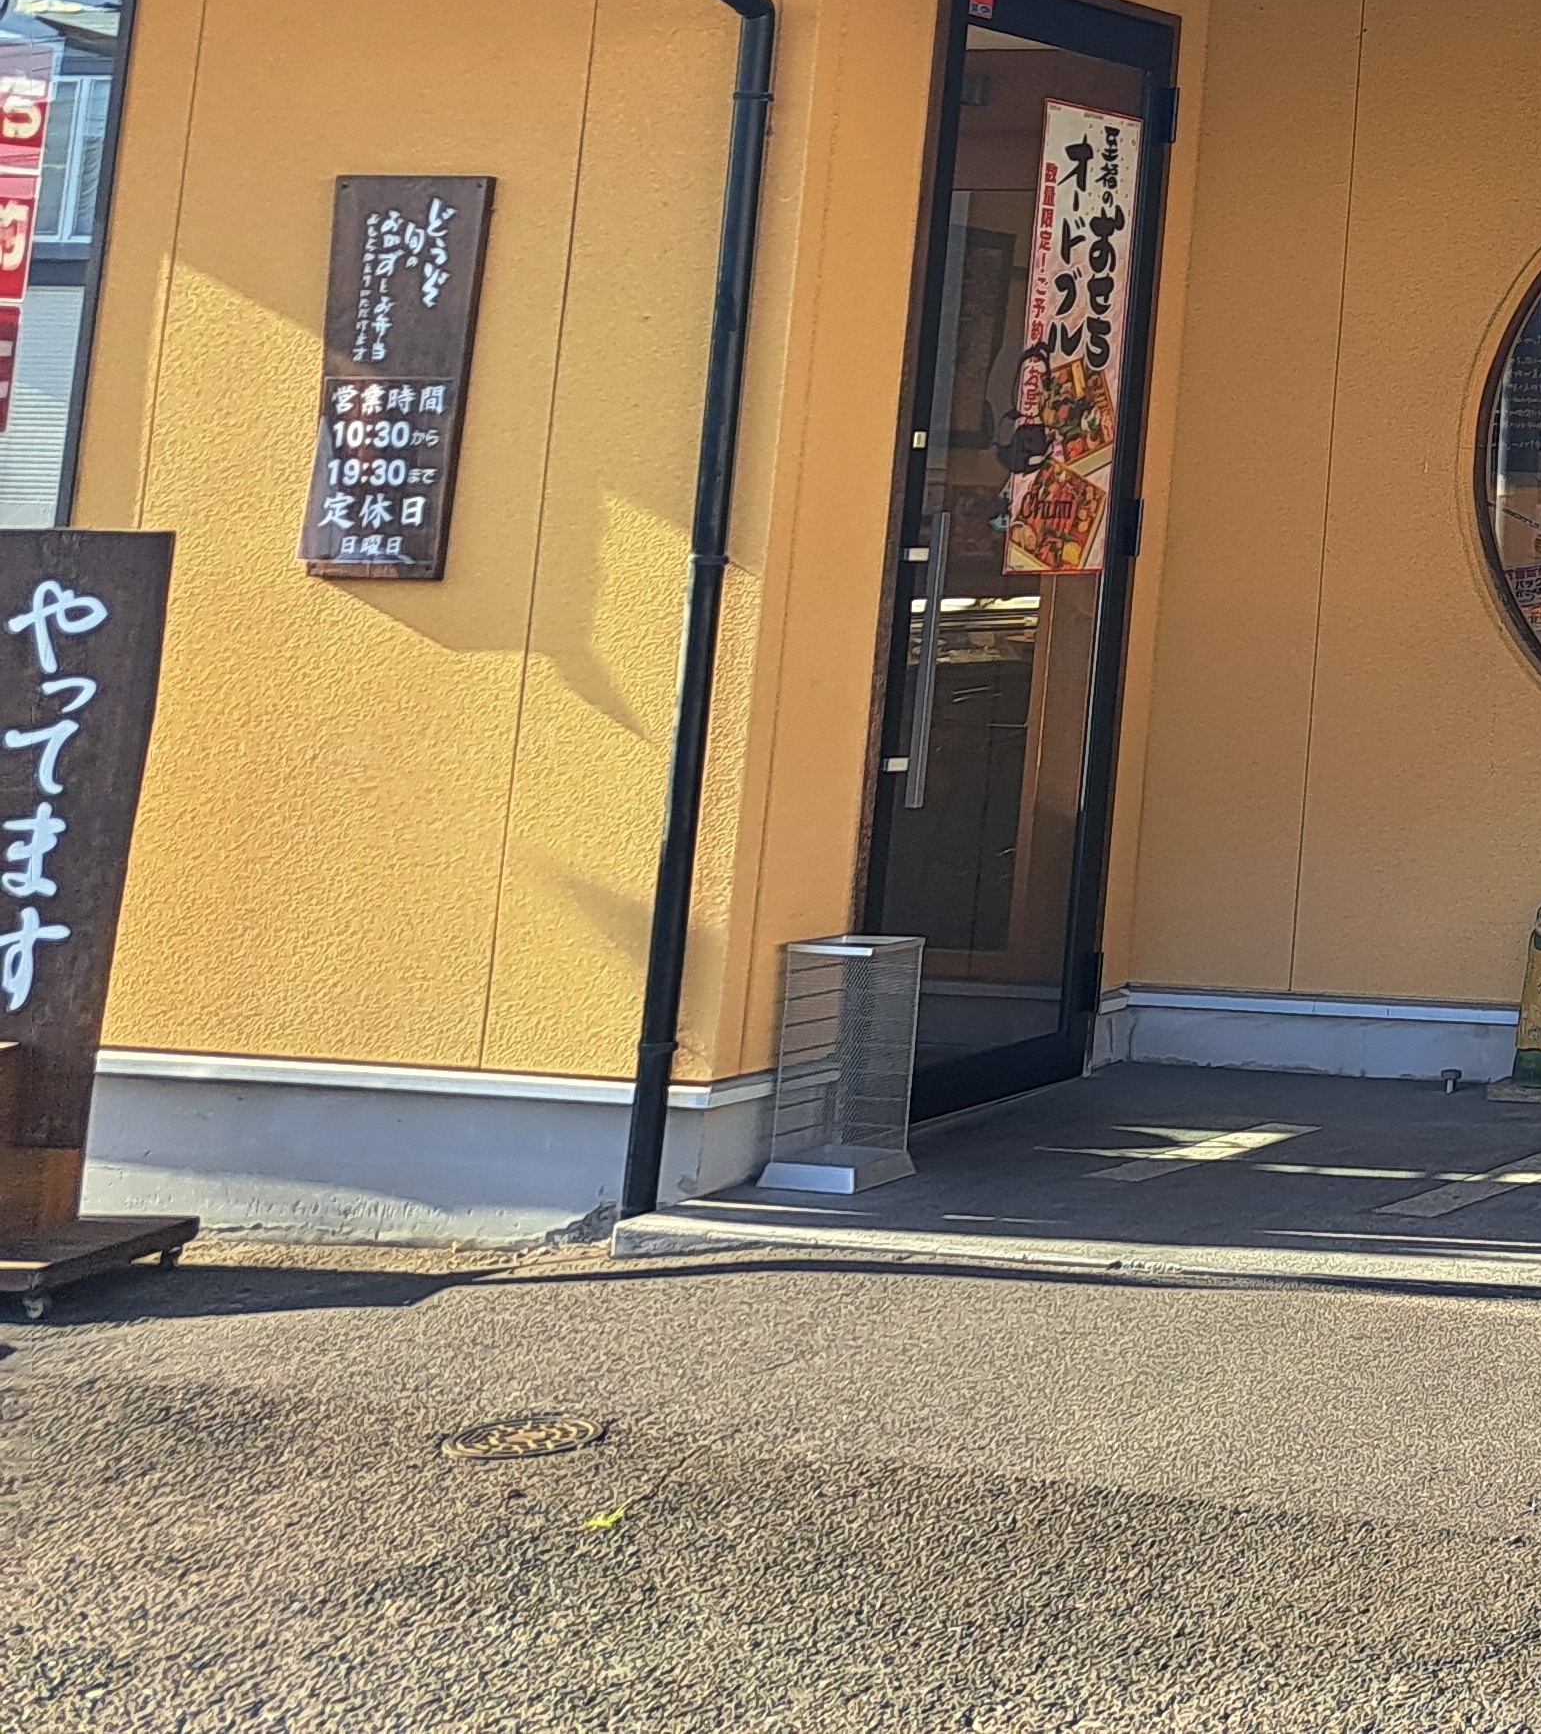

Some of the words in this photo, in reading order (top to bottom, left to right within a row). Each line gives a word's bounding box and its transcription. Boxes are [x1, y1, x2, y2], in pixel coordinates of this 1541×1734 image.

[404, 222, 425, 268] 旬の
[422, 197, 458, 308] どうぞ
[1049, 133, 1094, 358] オードブル
[331, 383, 447, 415] 営業時間
[333, 420, 441, 449] 10:30から
[327, 458, 438, 486] 19:30まで
[317, 492, 427, 529] 定休日
[340, 534, 404, 556] 日曜日
[0, 580, 109, 1012] やってます
